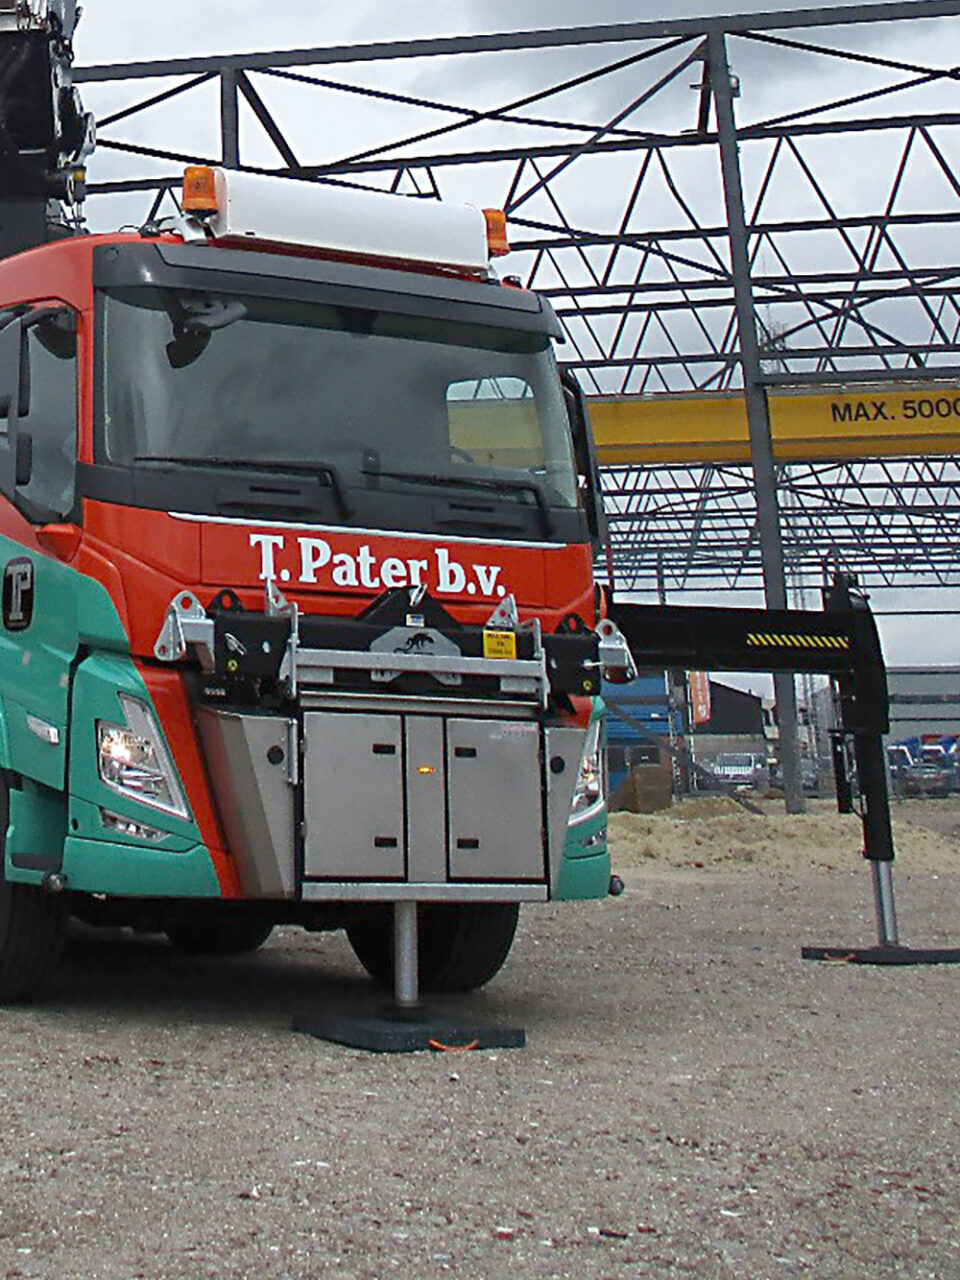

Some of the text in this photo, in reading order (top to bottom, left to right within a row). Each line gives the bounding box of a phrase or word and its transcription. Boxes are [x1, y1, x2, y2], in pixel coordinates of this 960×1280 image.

[831, 401, 895, 422] MAX.
[296, 537, 428, 588] Pater
[434, 548, 506, 597] b.v.
